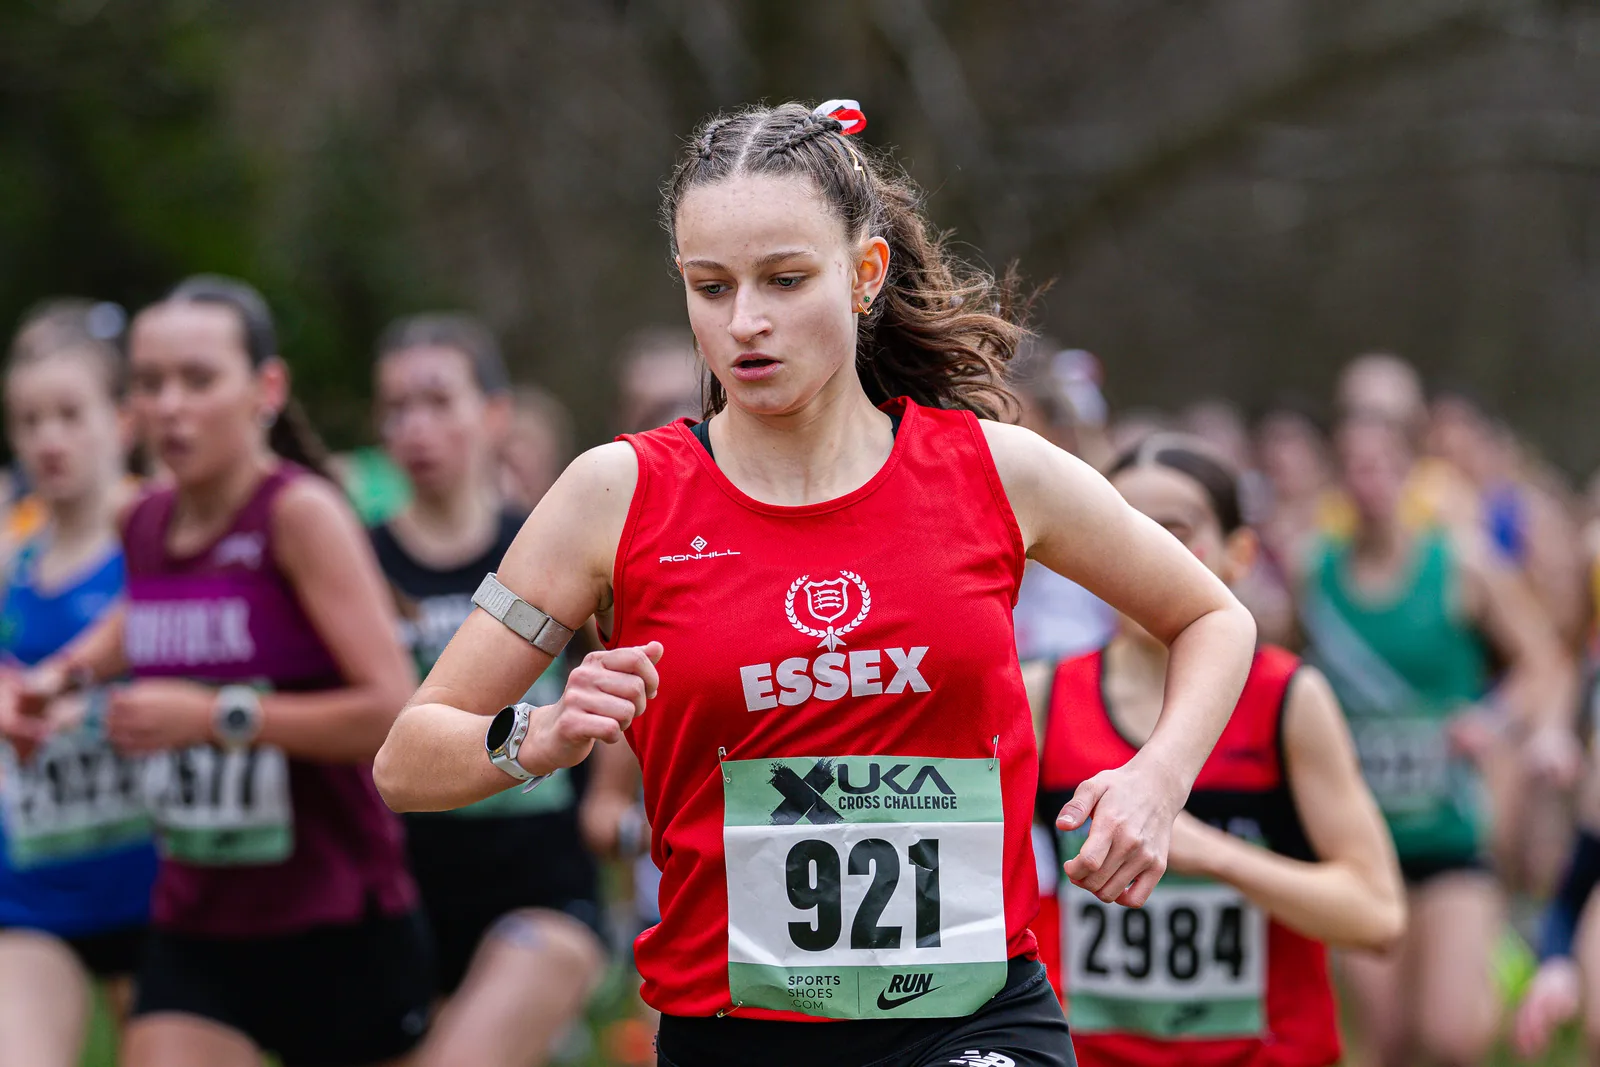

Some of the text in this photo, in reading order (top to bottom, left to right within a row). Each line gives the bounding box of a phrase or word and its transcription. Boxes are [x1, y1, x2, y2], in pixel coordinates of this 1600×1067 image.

[659, 549, 741, 564] RONHILL
[739, 646, 932, 712] ESSEX
[837, 763, 956, 795] UKA
[838, 795, 958, 810] CROSS CHALLENGE
[785, 838, 942, 952] 921
[1080, 902, 1244, 981] 2984
[788, 975, 841, 986] SPORTS
[888, 973, 934, 993] RUN
[788, 988, 833, 999] SHOES
[791, 1000, 824, 1011] .COM
